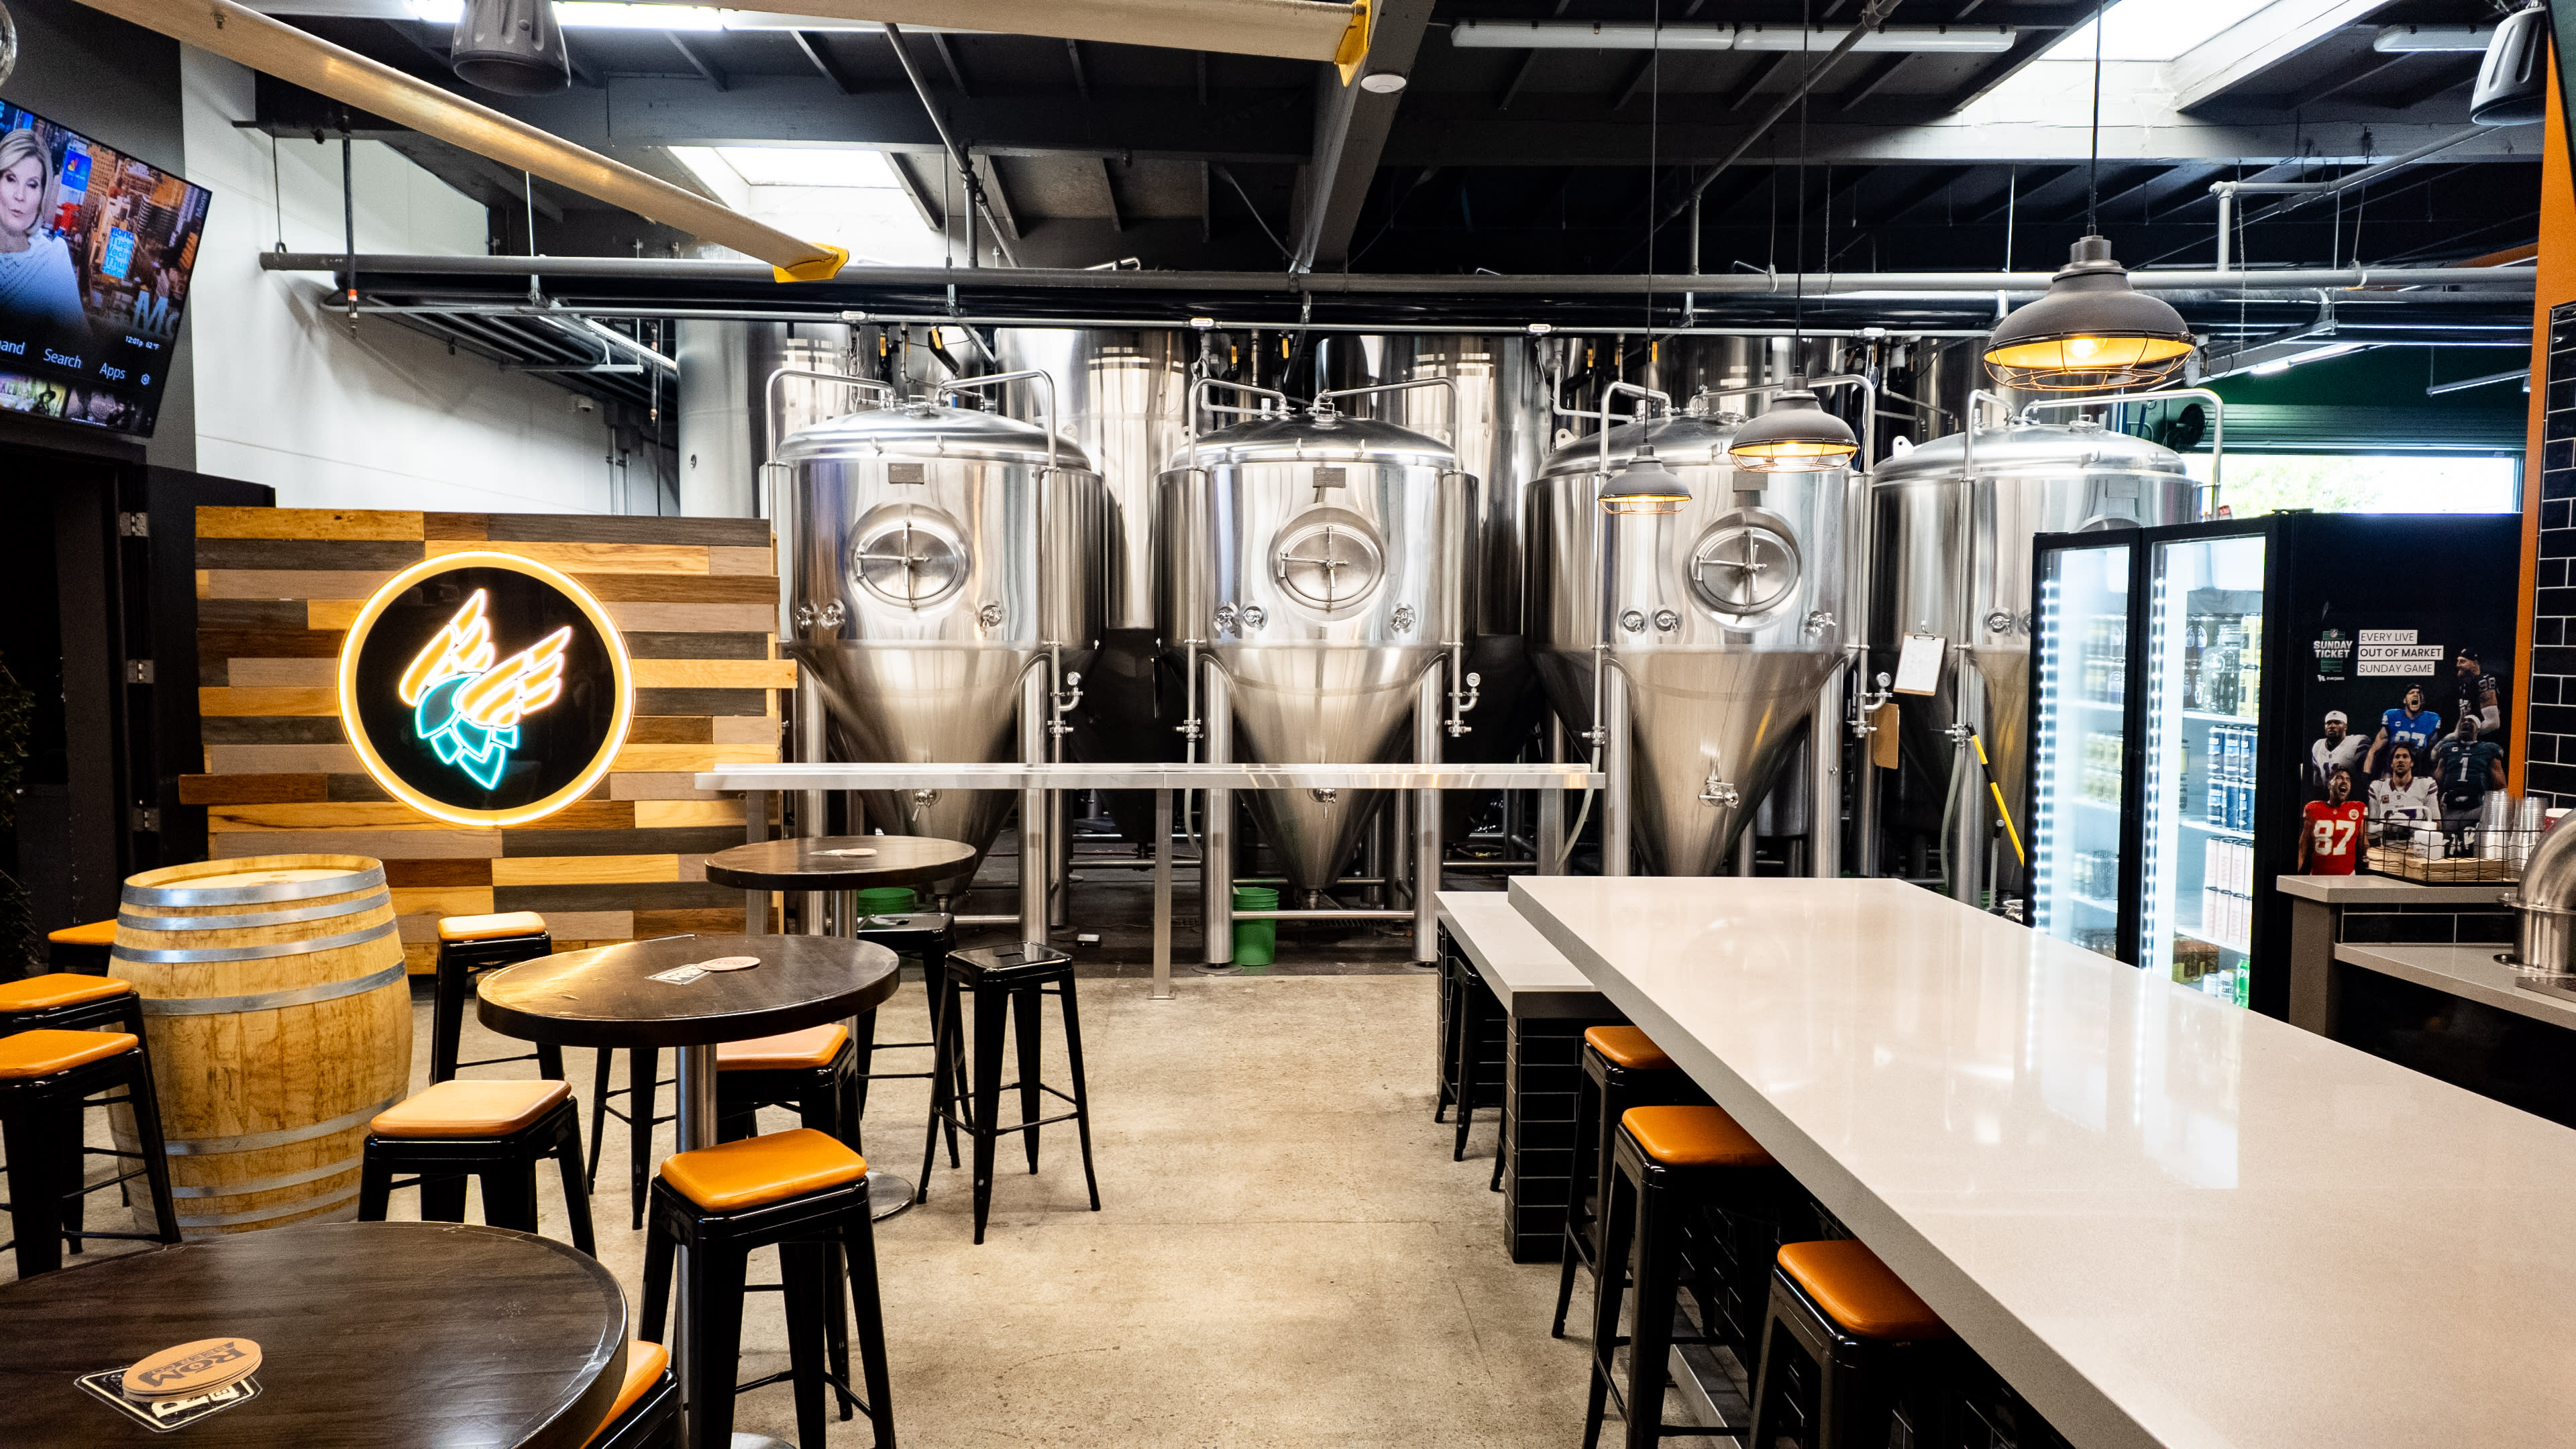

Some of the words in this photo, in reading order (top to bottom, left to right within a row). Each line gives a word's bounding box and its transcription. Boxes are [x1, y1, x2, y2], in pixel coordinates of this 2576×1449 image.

[43, 348, 82, 368] Search
[99, 362, 125, 380] Apps
[2361, 633, 2392, 641] EVERY
[2395, 633, 2414, 641] LIVE
[2314, 641, 2353, 649] SUNDAY
[2315, 649, 2350, 658] TICKET
[2360, 648, 2382, 657] OUT
[2385, 648, 2399, 657] OF
[2402, 648, 2442, 657] MARKET
[2359, 664, 2402, 674] SUNDAY
[2404, 664, 2432, 674] GAME
[2314, 820, 2357, 856] 87
